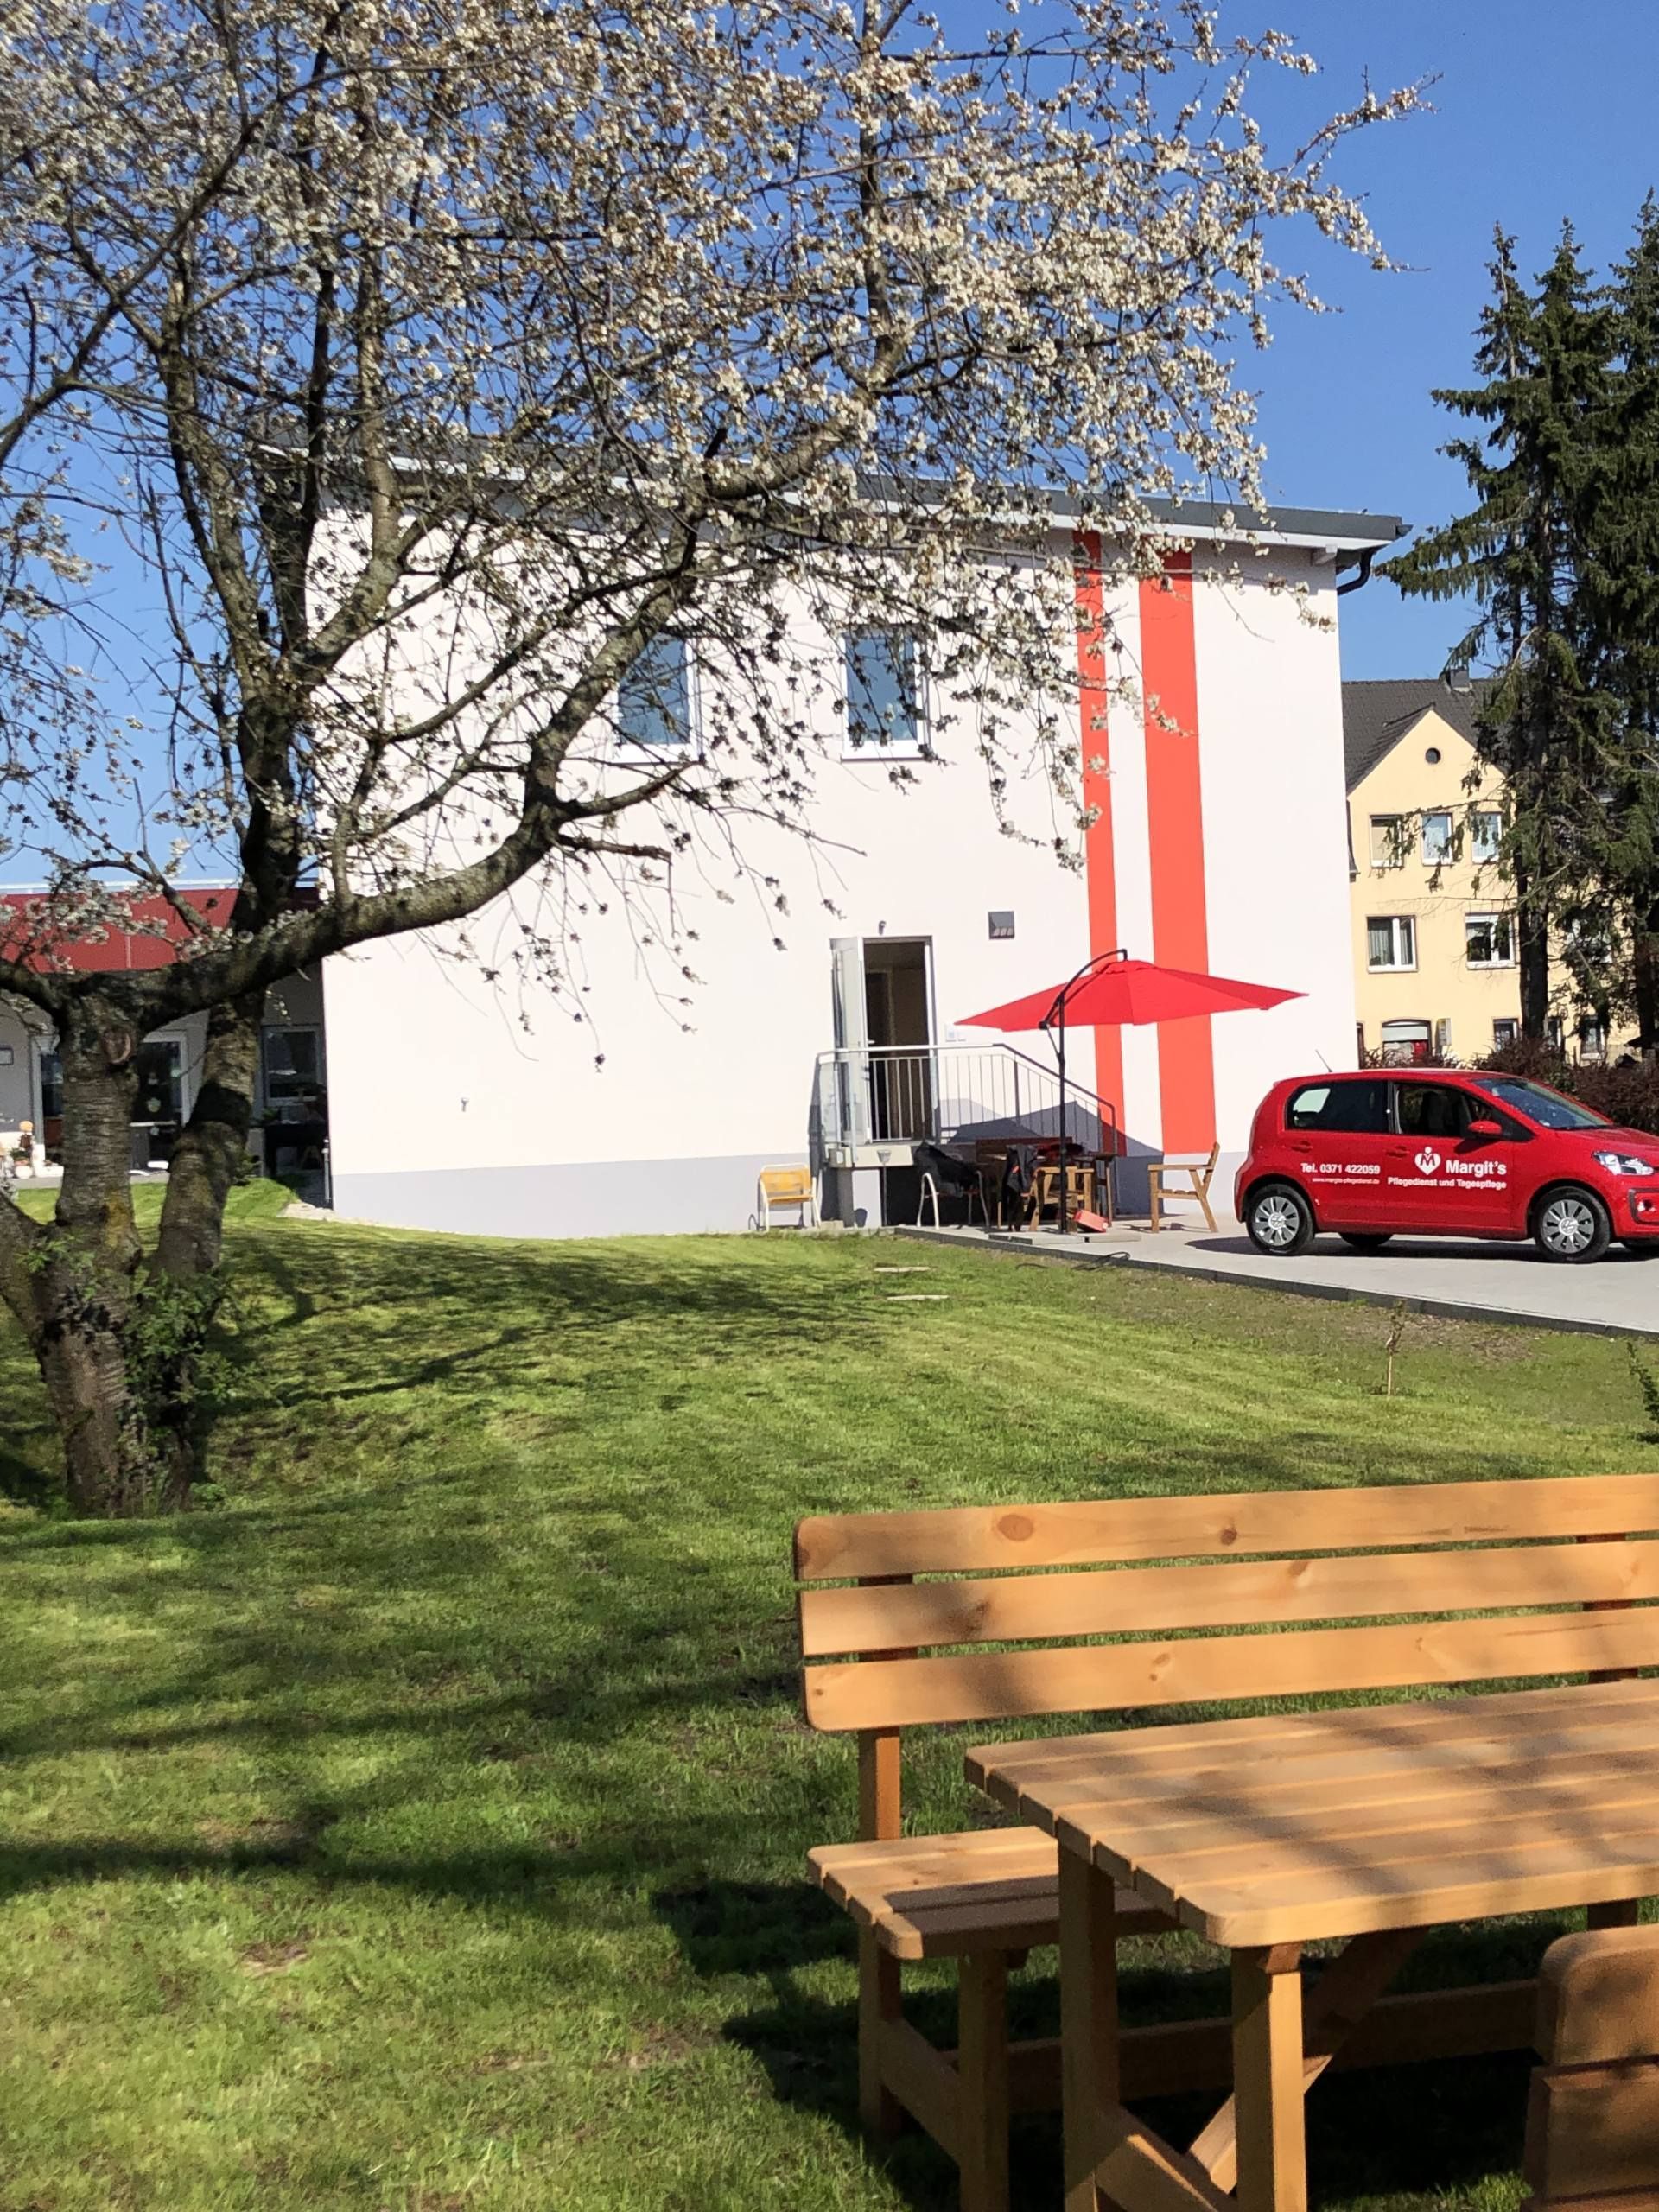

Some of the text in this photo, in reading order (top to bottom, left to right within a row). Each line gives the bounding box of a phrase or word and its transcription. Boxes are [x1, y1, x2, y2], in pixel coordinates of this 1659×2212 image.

[1300, 1162, 1381, 1175] Tel. 0371 422059
[1446, 1160, 1507, 1178] Margit's
[1387, 1176, 1438, 1187] Pflegedienst
[1439, 1179, 1455, 1187] und
[1456, 1179, 1507, 1190] Tagespflege
